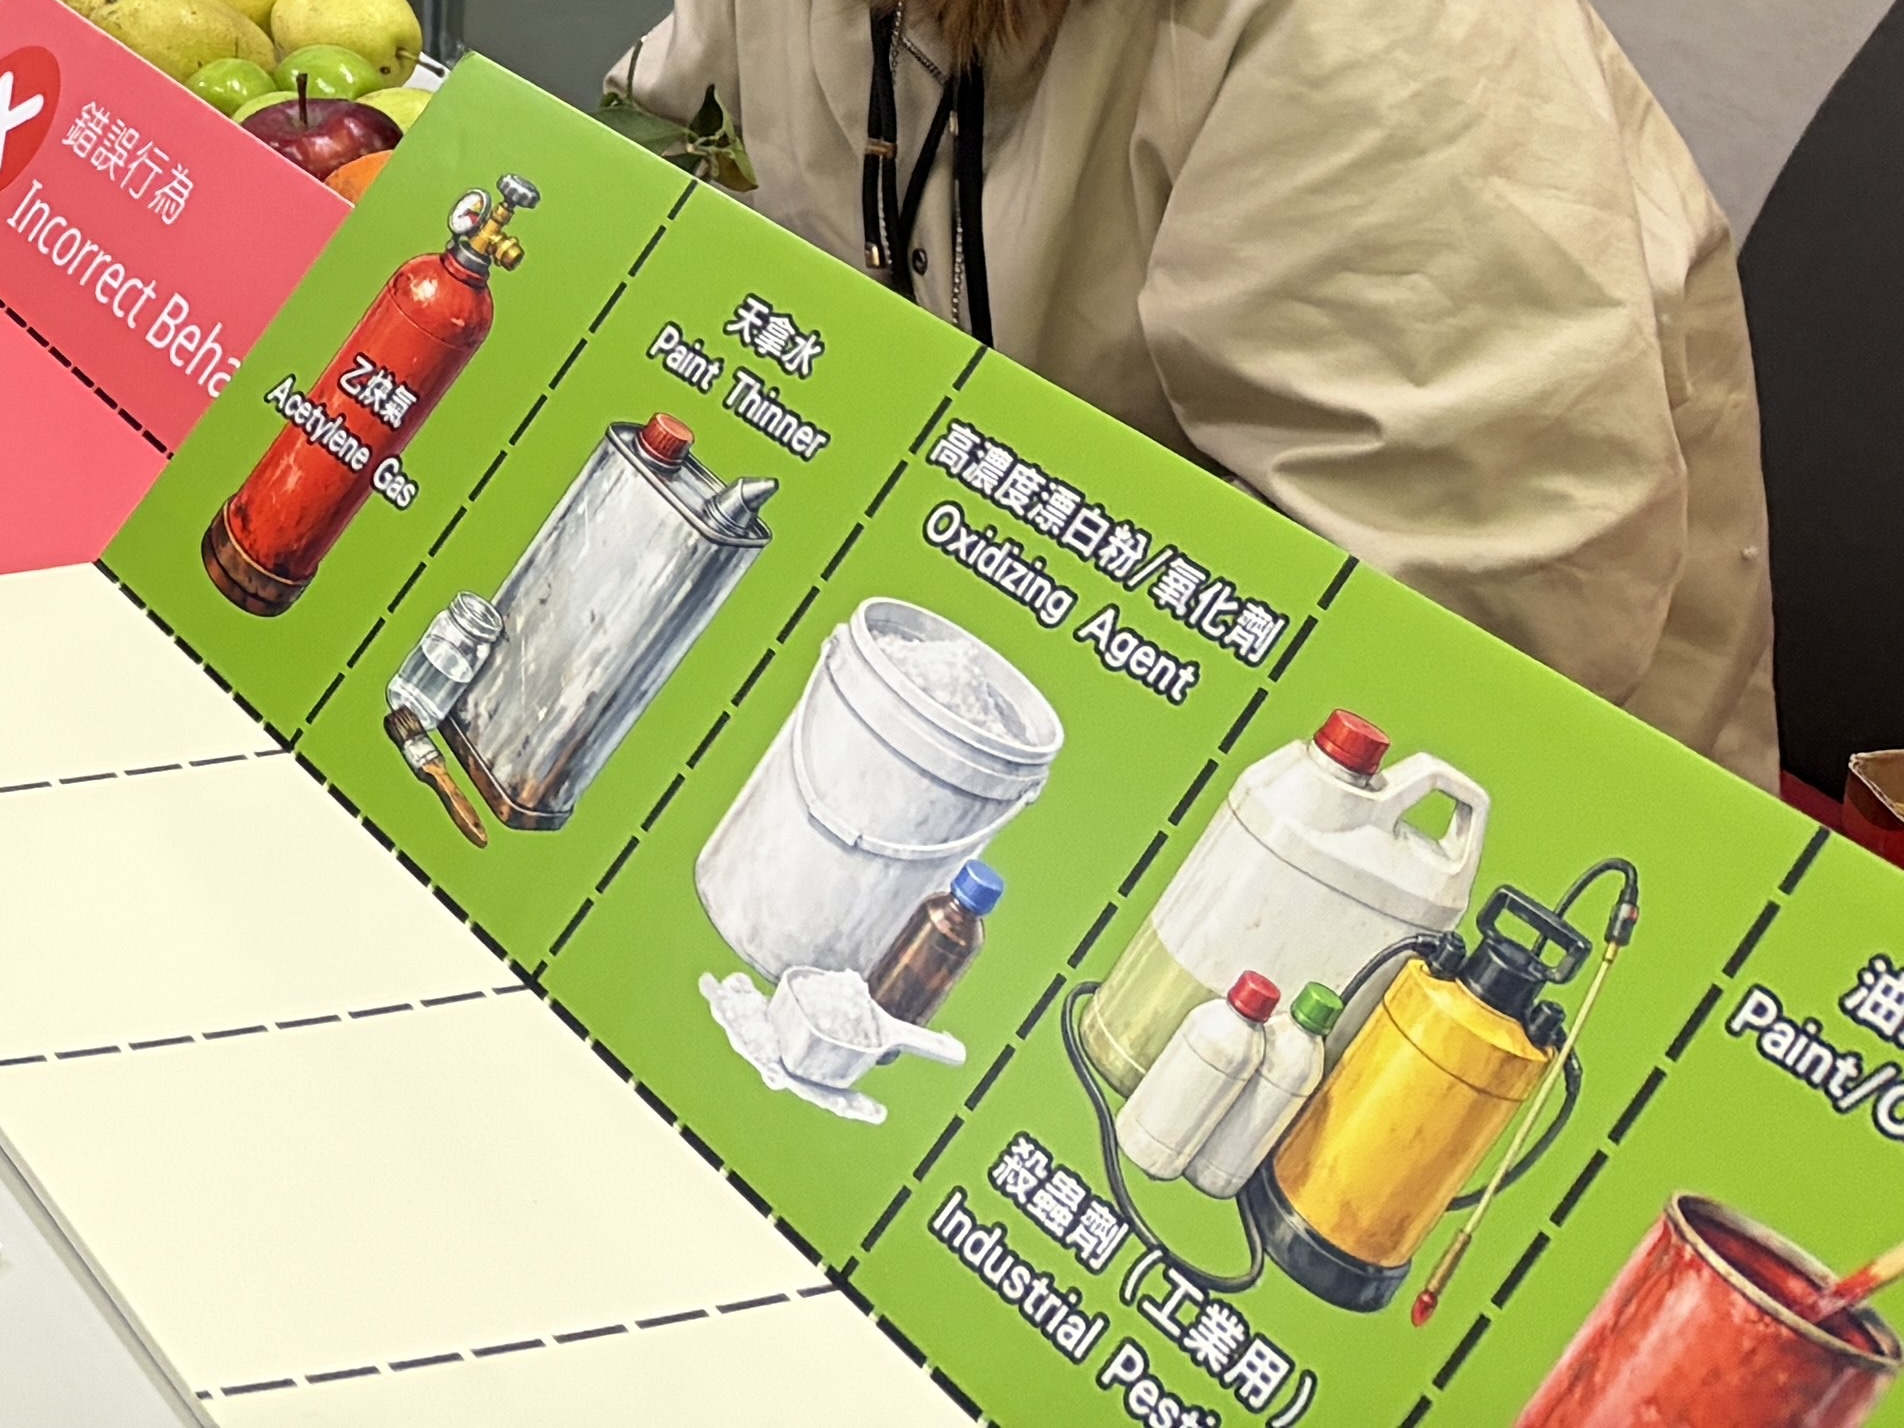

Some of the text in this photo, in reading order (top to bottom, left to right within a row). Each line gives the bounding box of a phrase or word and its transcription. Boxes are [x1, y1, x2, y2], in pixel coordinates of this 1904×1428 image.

[61, 100, 195, 226] 錯誤行為
[5, 178, 158, 330] Incorrect
[339, 353, 419, 431] 乙炔氣
[648, 323, 829, 460] Paint Thinner
[725, 295, 823, 377] 天拿水
[266, 375, 418, 509] Acetylene Gas
[925, 501, 1199, 704] Oxidizing Agent
[929, 1186, 1221, 1428] Industrial Pes
